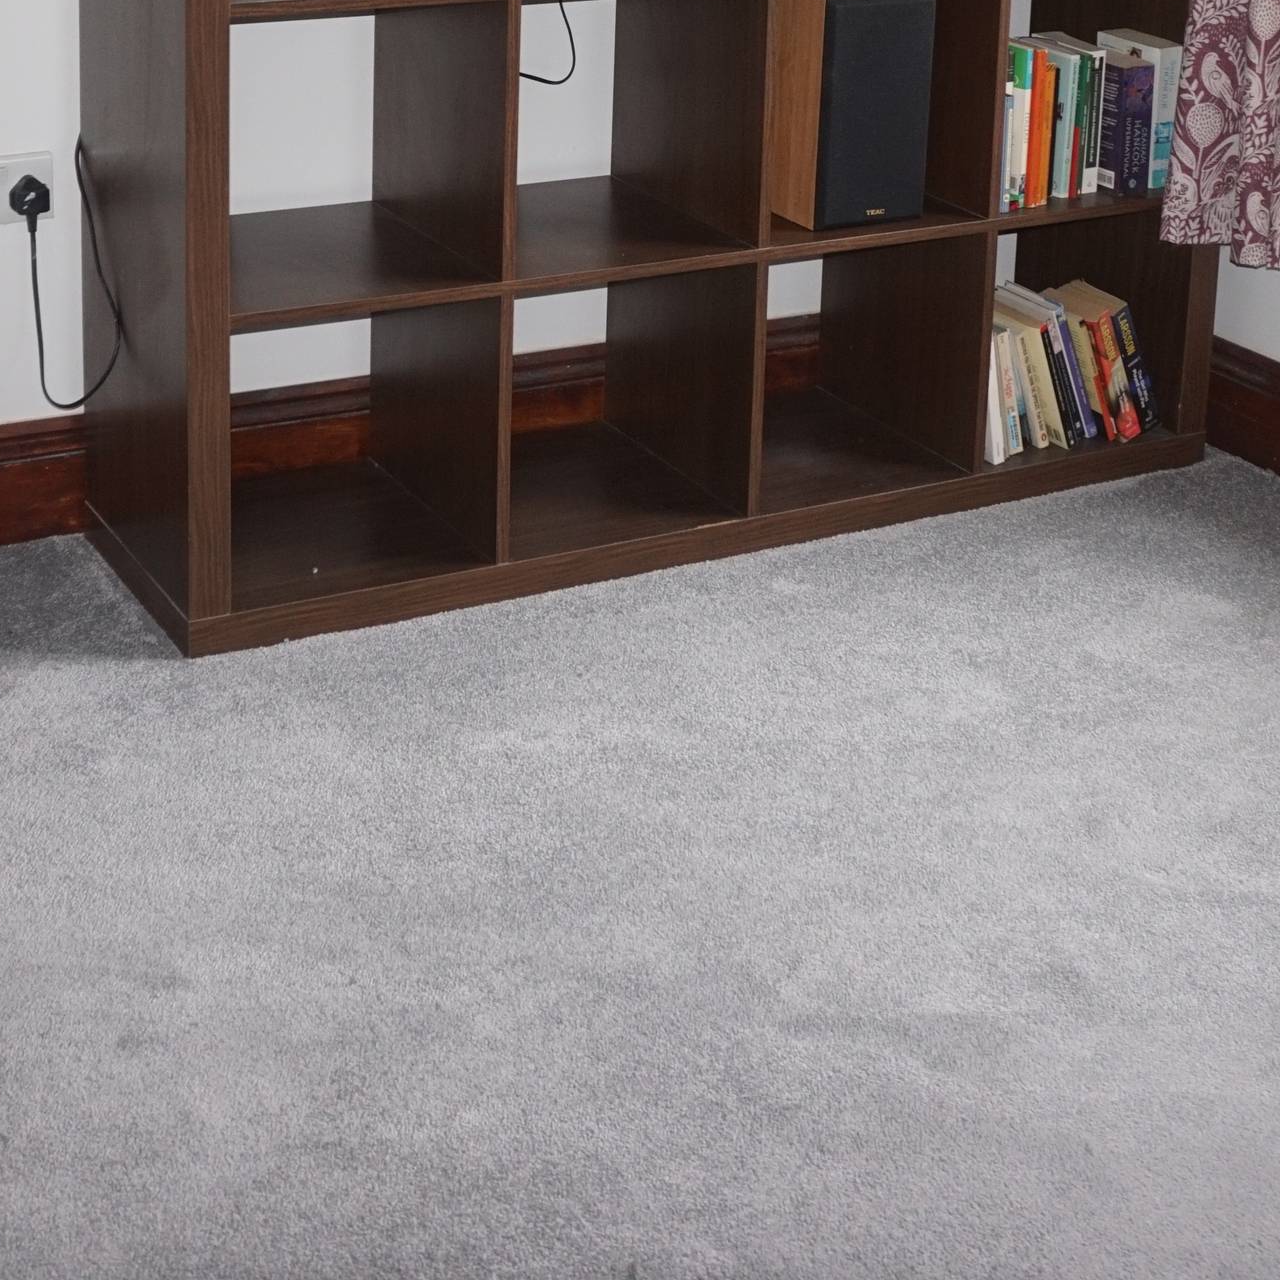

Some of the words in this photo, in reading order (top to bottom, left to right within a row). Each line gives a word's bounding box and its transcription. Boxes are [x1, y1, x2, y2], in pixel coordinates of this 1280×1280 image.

[1122, 116, 1132, 178] SUPERNATURAL
[1131, 120, 1143, 174] HANCOCK
[866, 208, 886, 216] TEAC
[1101, 321, 1116, 361] LARSSON
[1119, 313, 1136, 355] LARSSON
